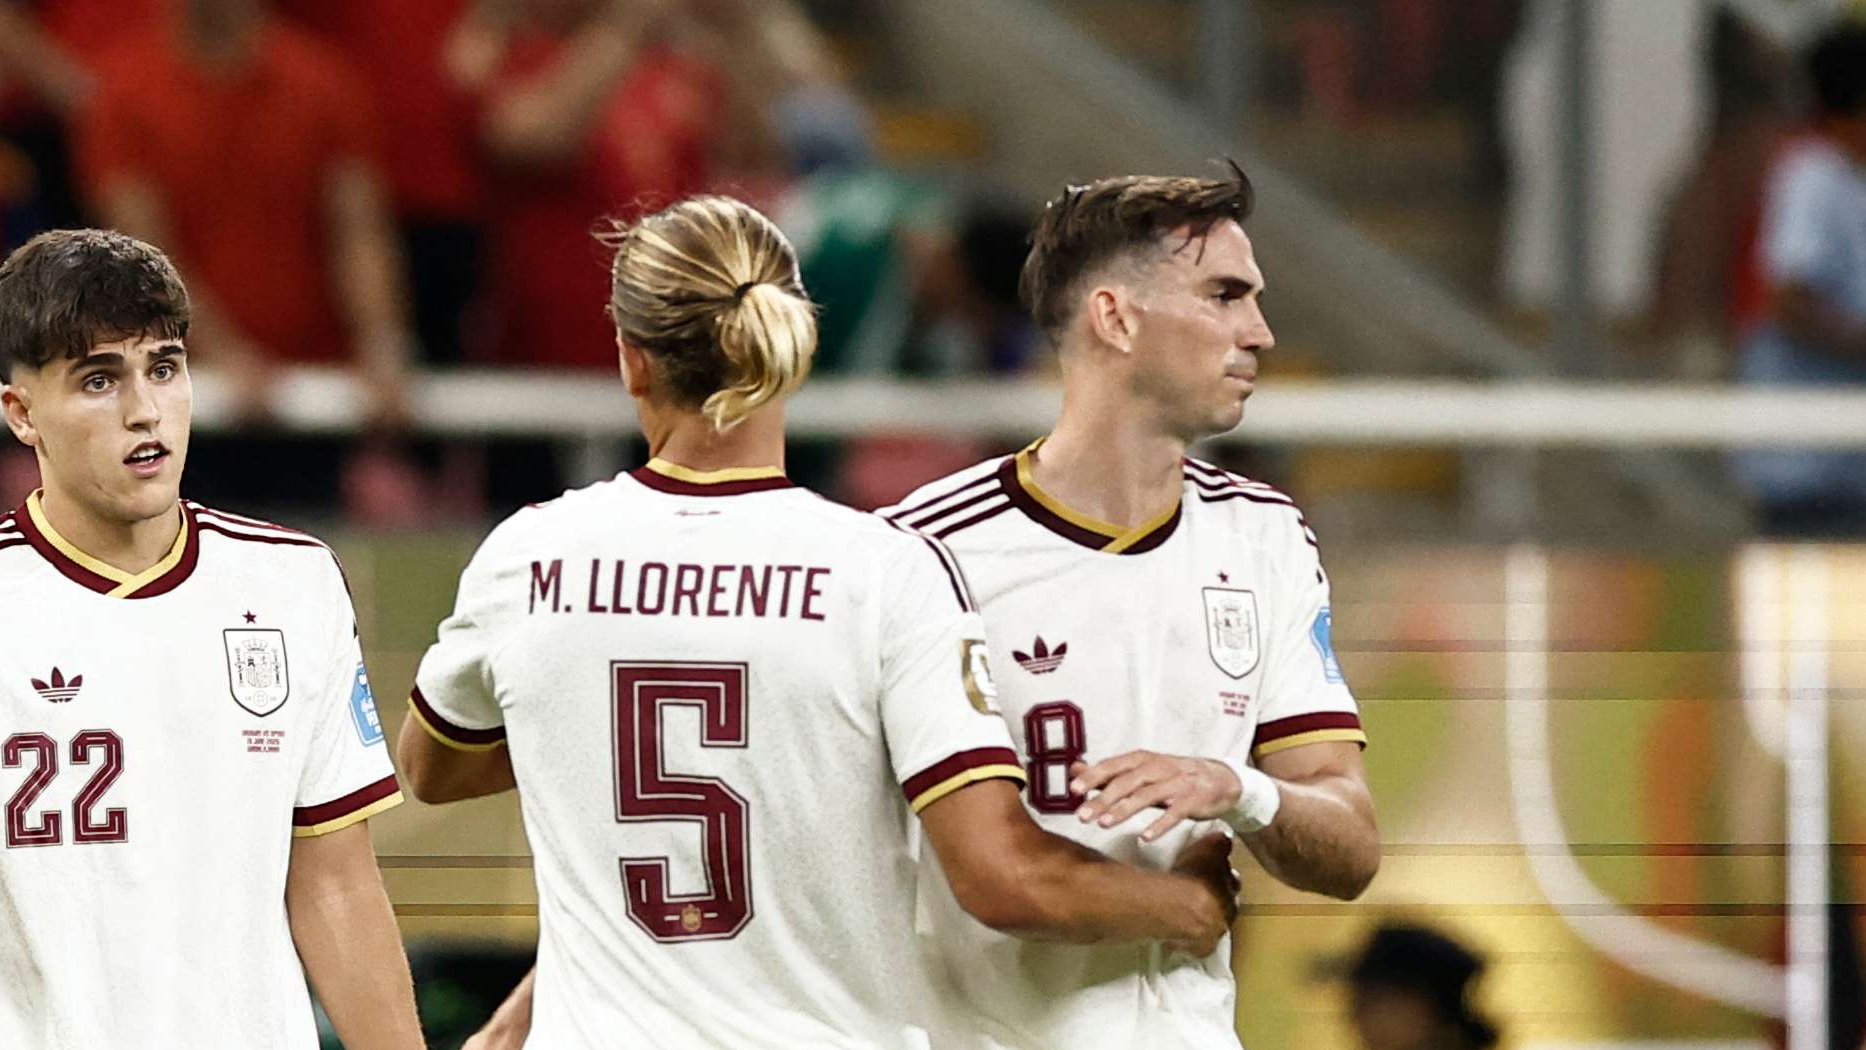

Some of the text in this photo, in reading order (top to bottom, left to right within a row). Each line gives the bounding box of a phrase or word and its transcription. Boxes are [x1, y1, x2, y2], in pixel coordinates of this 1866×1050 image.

[529, 558, 831, 621] M. LLORENTE
[1, 728, 129, 849] 22
[610, 660, 754, 944] 5
[1023, 700, 1086, 815] 8
